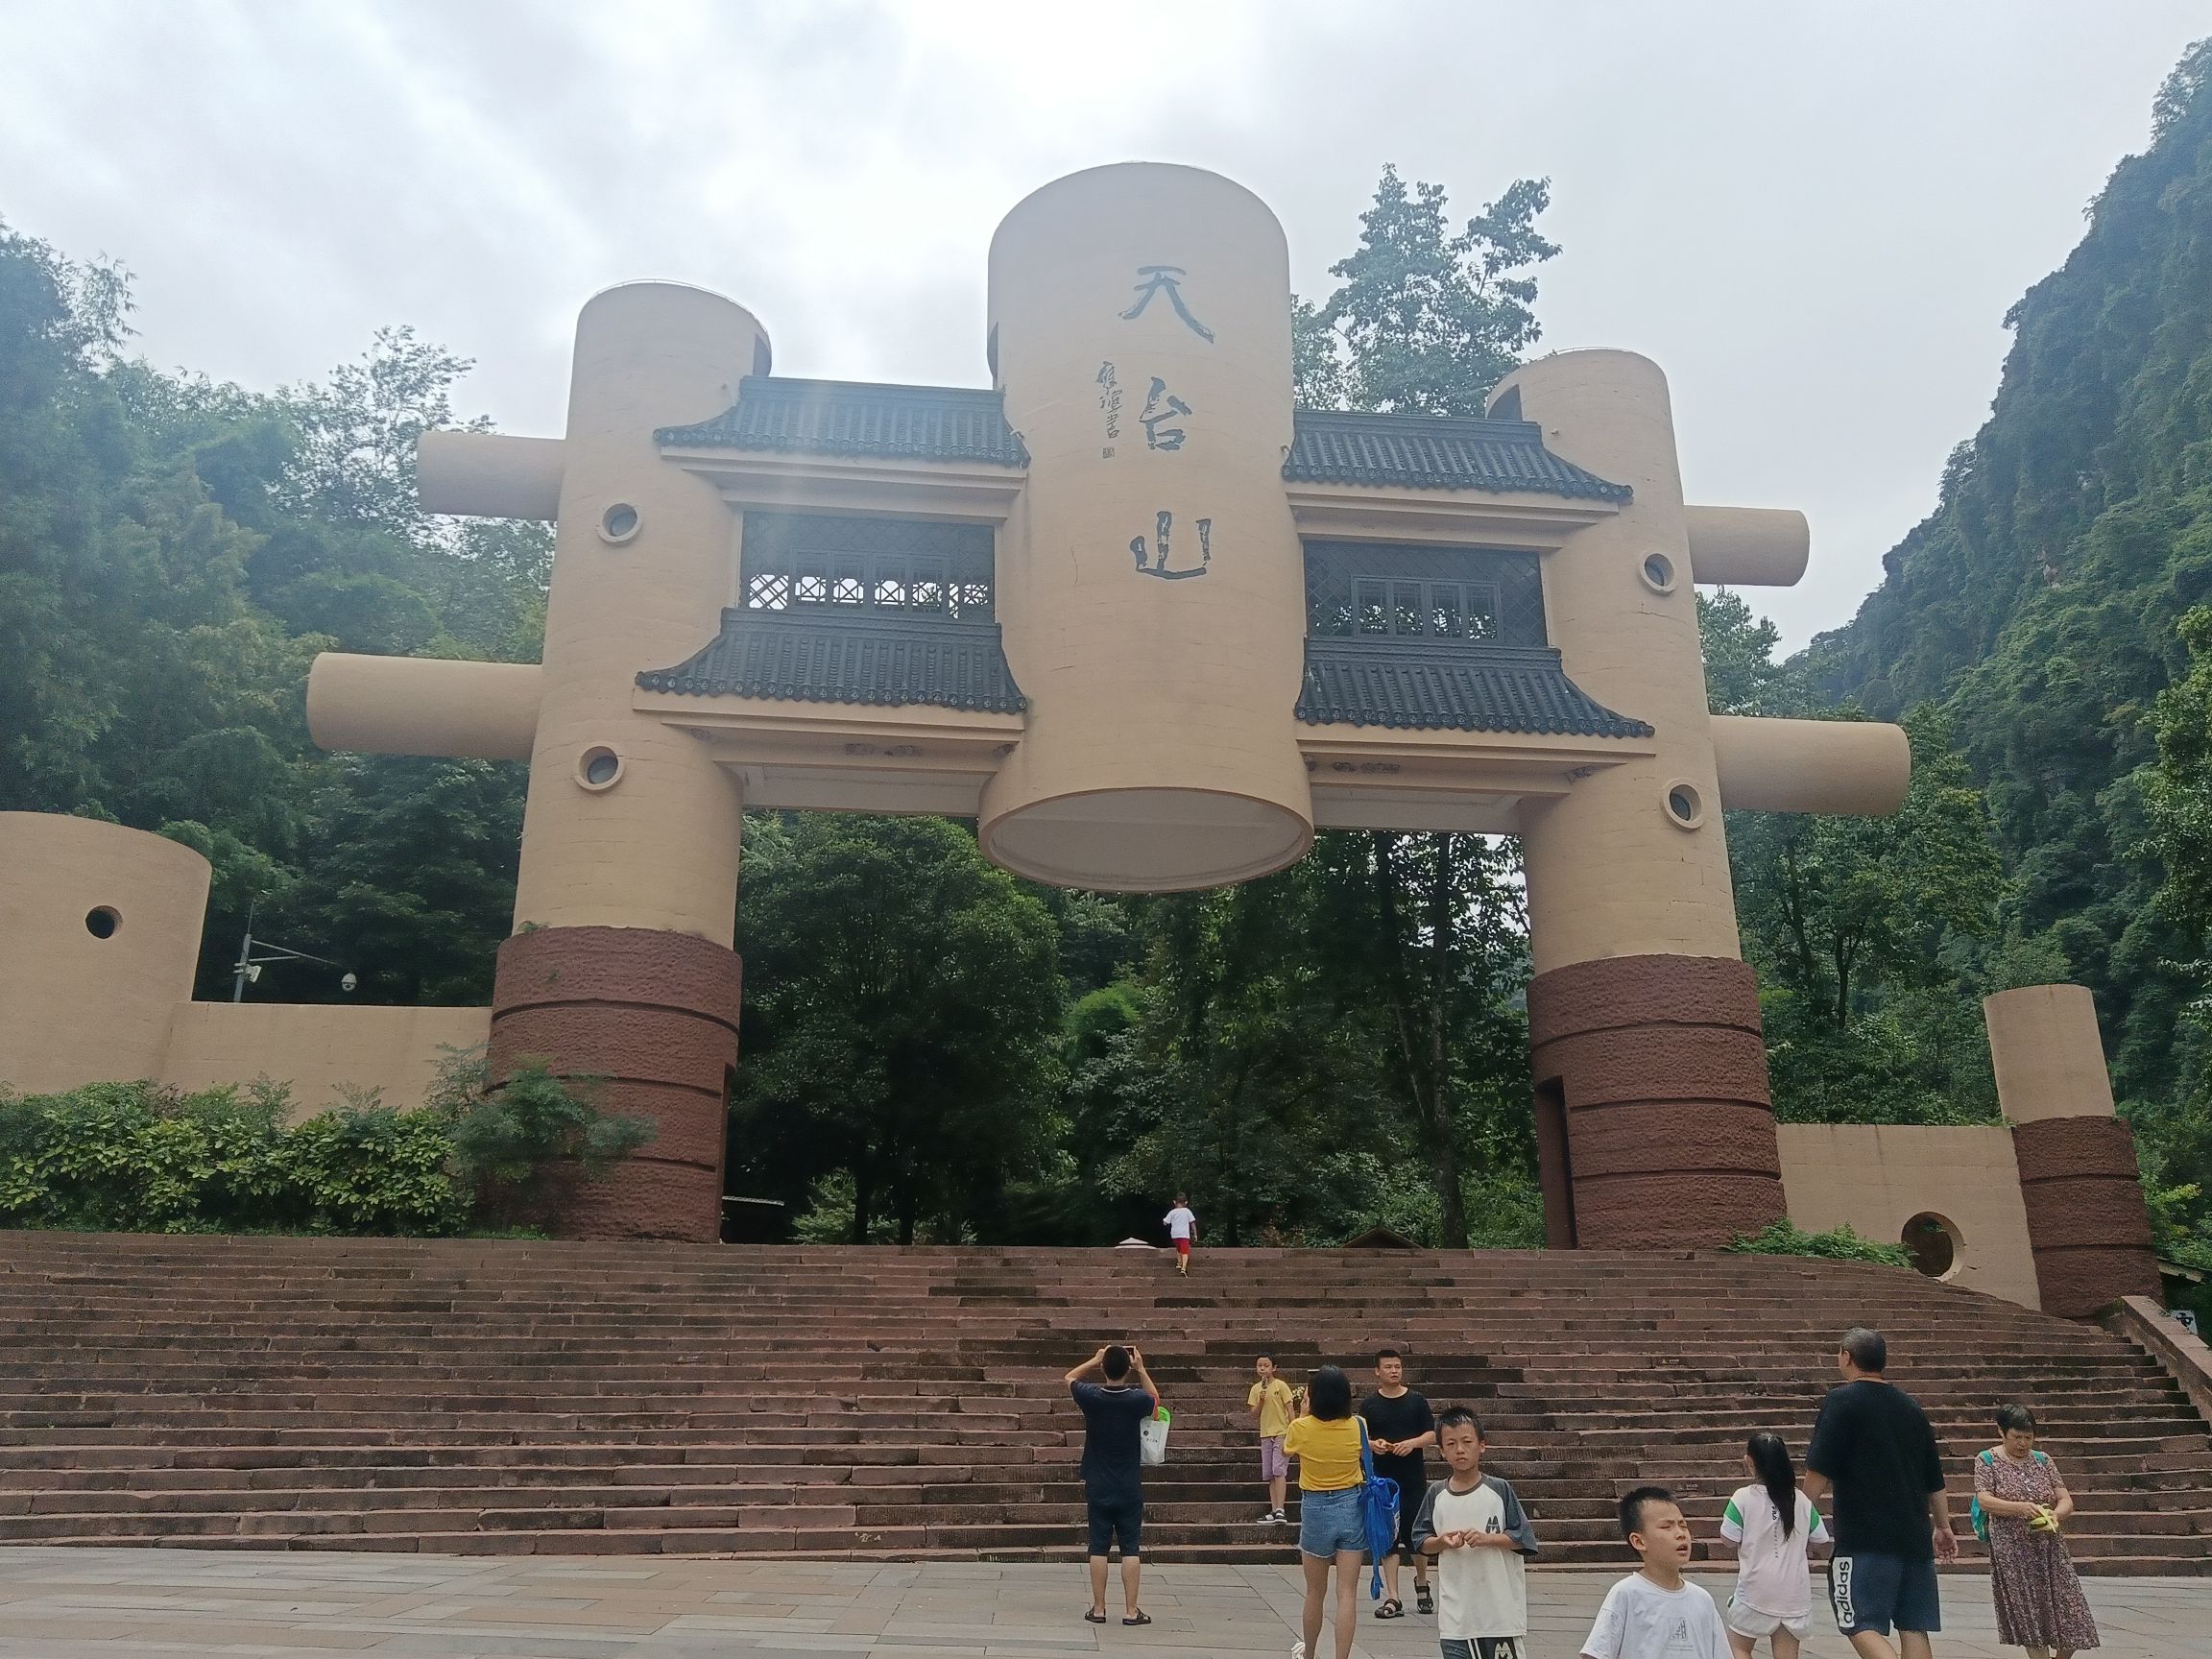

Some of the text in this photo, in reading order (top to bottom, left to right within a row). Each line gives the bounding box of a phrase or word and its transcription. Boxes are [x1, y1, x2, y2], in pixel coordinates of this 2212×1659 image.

[1118, 264, 1216, 581] 天台山
[1837, 1560, 1853, 1624] adidas
